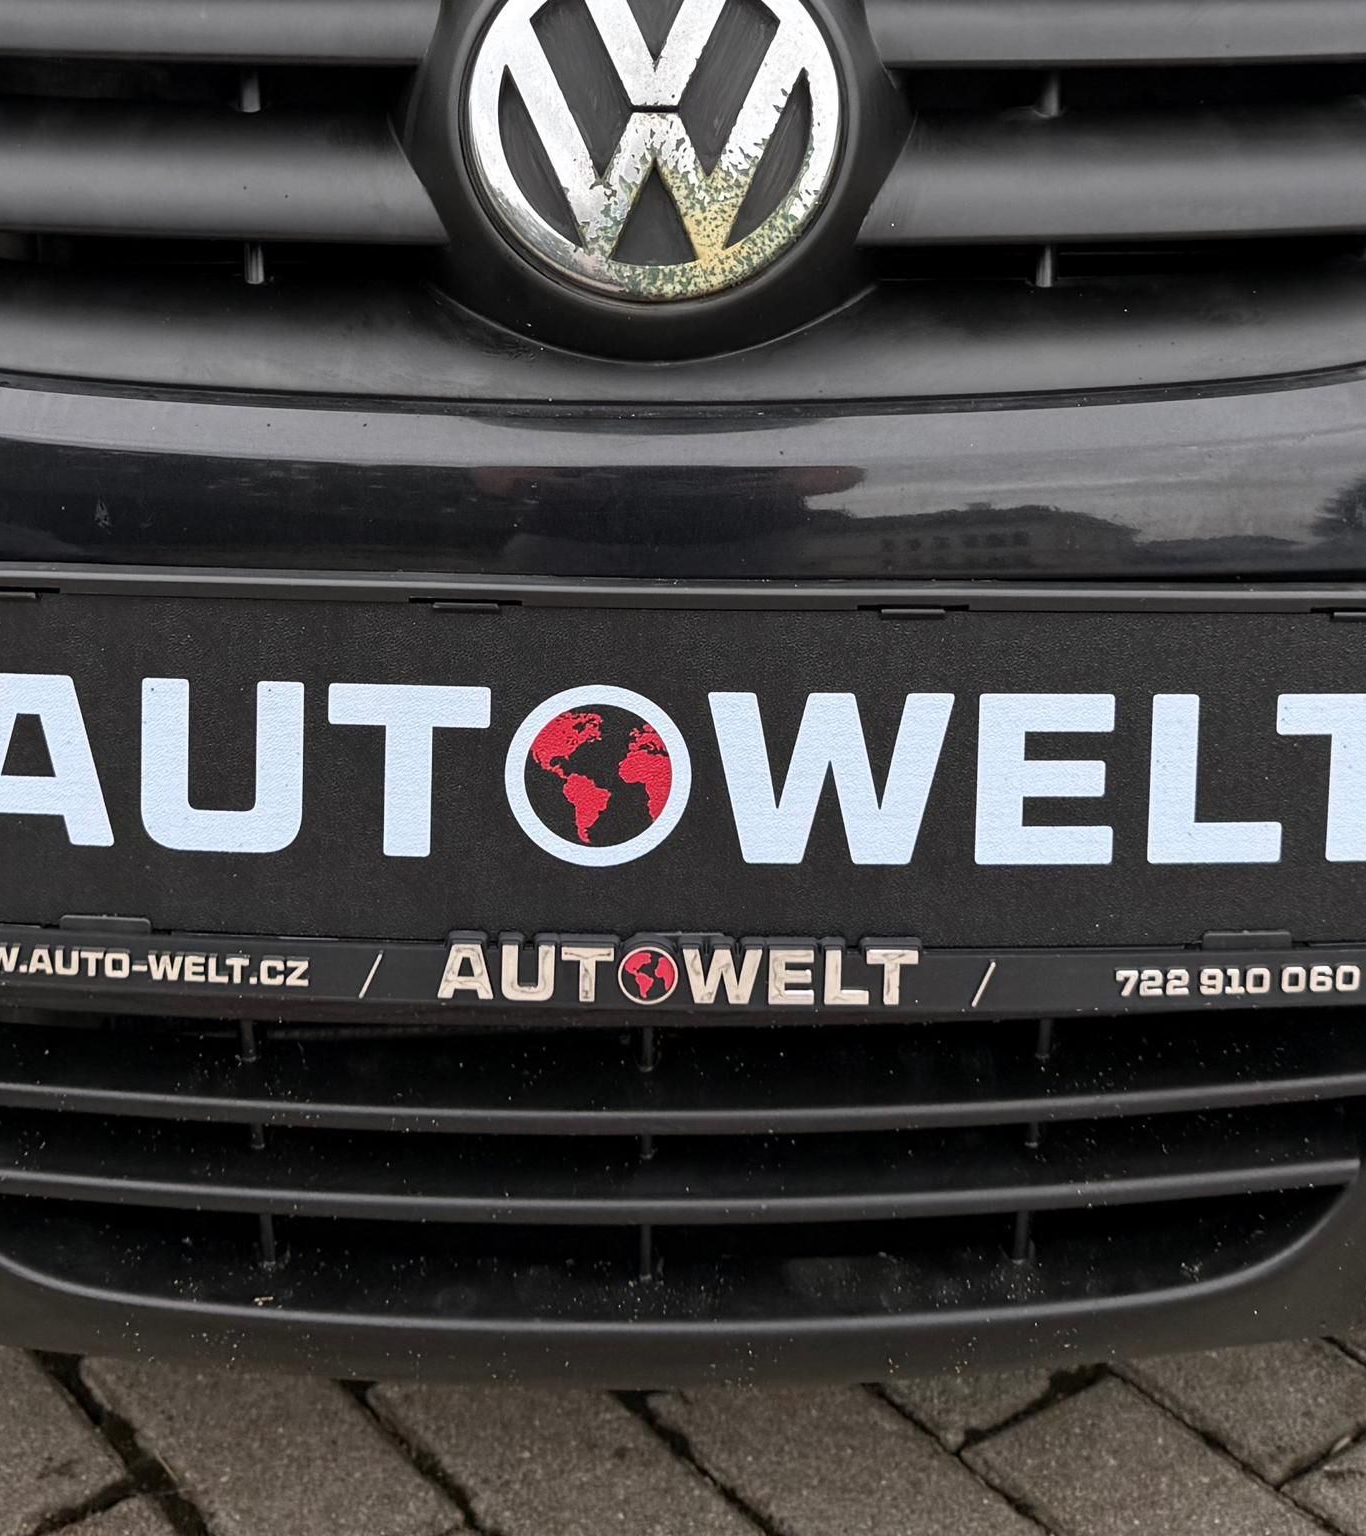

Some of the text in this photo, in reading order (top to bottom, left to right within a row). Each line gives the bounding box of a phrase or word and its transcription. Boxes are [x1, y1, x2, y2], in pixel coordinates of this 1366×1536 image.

[1116, 968, 1190, 997] 722
[1199, 967, 1271, 996] 910
[1281, 965, 1361, 994] 060
